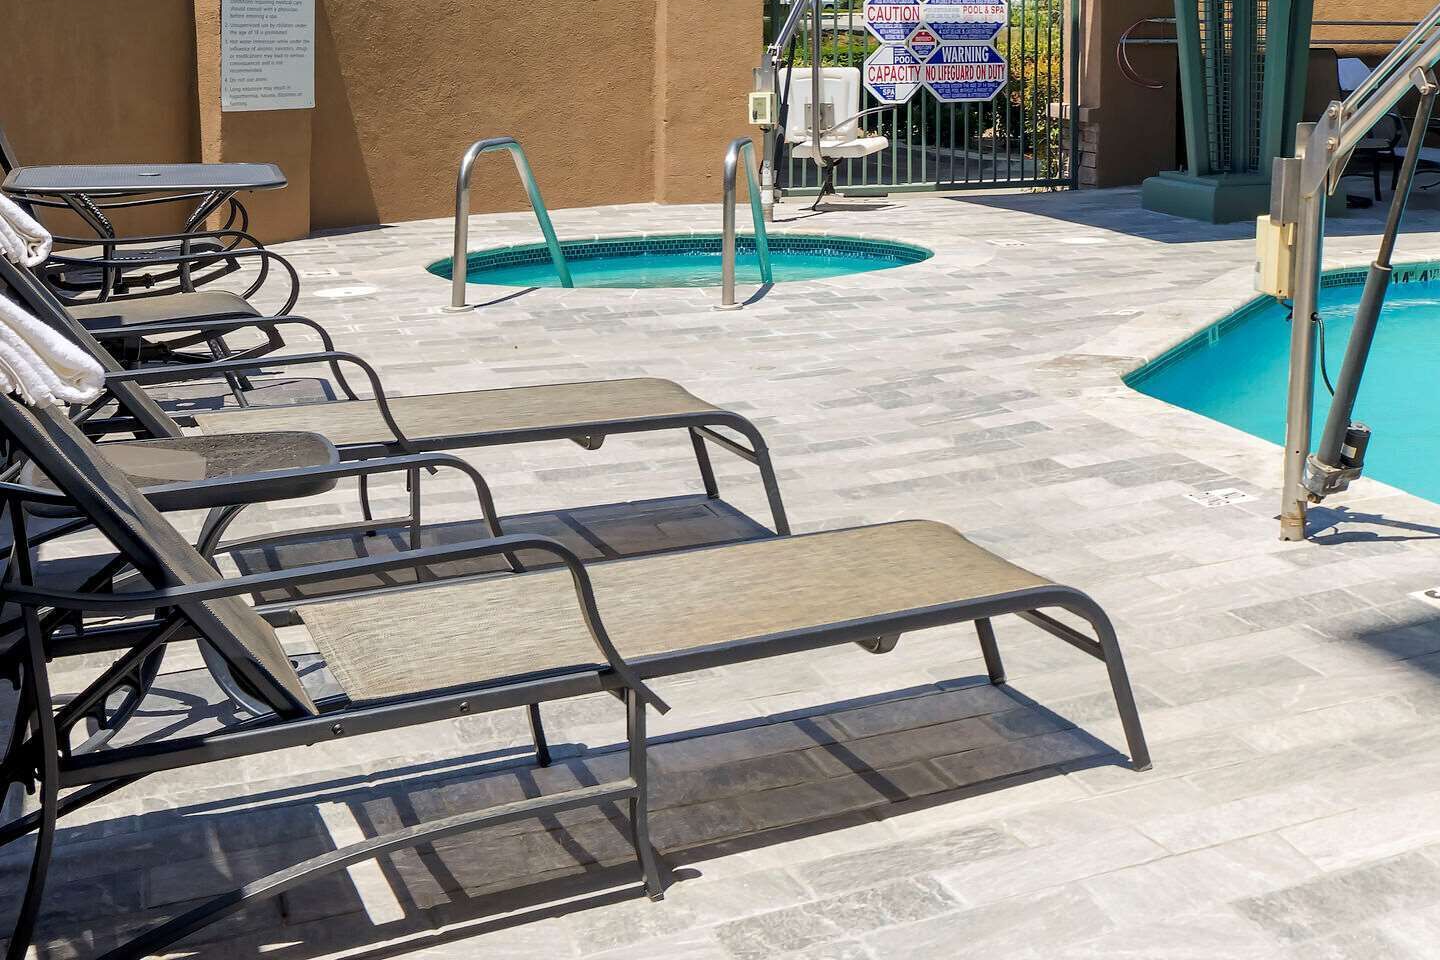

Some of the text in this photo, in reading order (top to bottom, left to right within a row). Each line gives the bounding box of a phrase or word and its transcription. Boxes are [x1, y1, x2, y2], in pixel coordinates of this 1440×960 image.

[868, 6, 920, 21] CAUTION
[962, 6, 983, 14] POOL
[984, 6, 989, 14] &
[991, 6, 1004, 14] SPA
[894, 55, 915, 64] POOL
[942, 46, 989, 63] WARNING
[868, 65, 920, 82] CAPACITY
[925, 64, 1005, 81] NO LIFEGUARD ON DUTY
[882, 88, 895, 96] SPA
